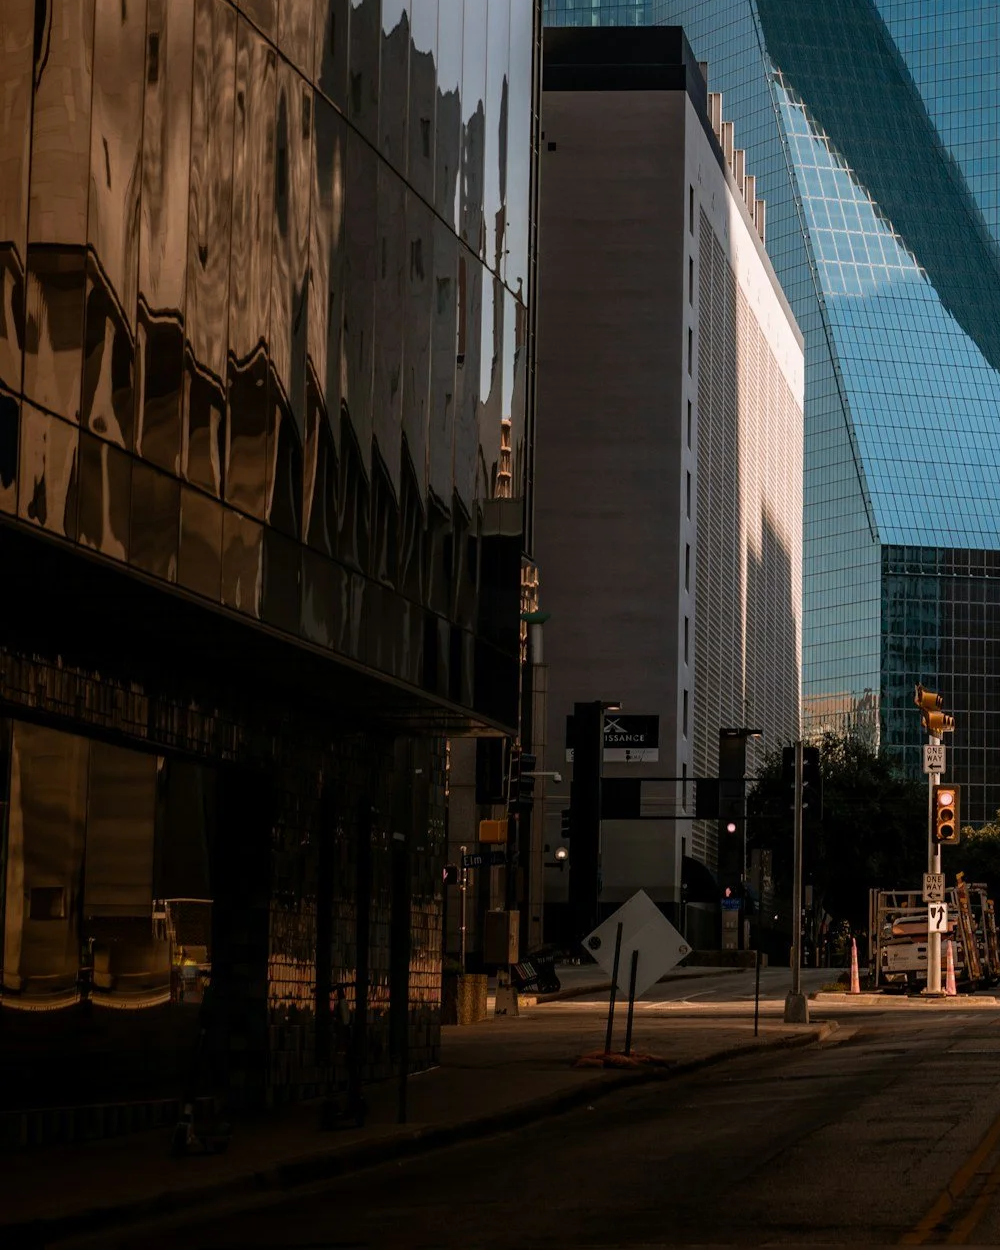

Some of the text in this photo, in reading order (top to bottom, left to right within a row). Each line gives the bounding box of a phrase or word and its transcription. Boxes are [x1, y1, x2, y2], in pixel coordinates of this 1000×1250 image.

[604, 734, 645, 742] ISSANCE
[926, 747, 943, 755] ONE
[463, 855, 482, 867] Elm
[926, 875, 942, 883] ONE
